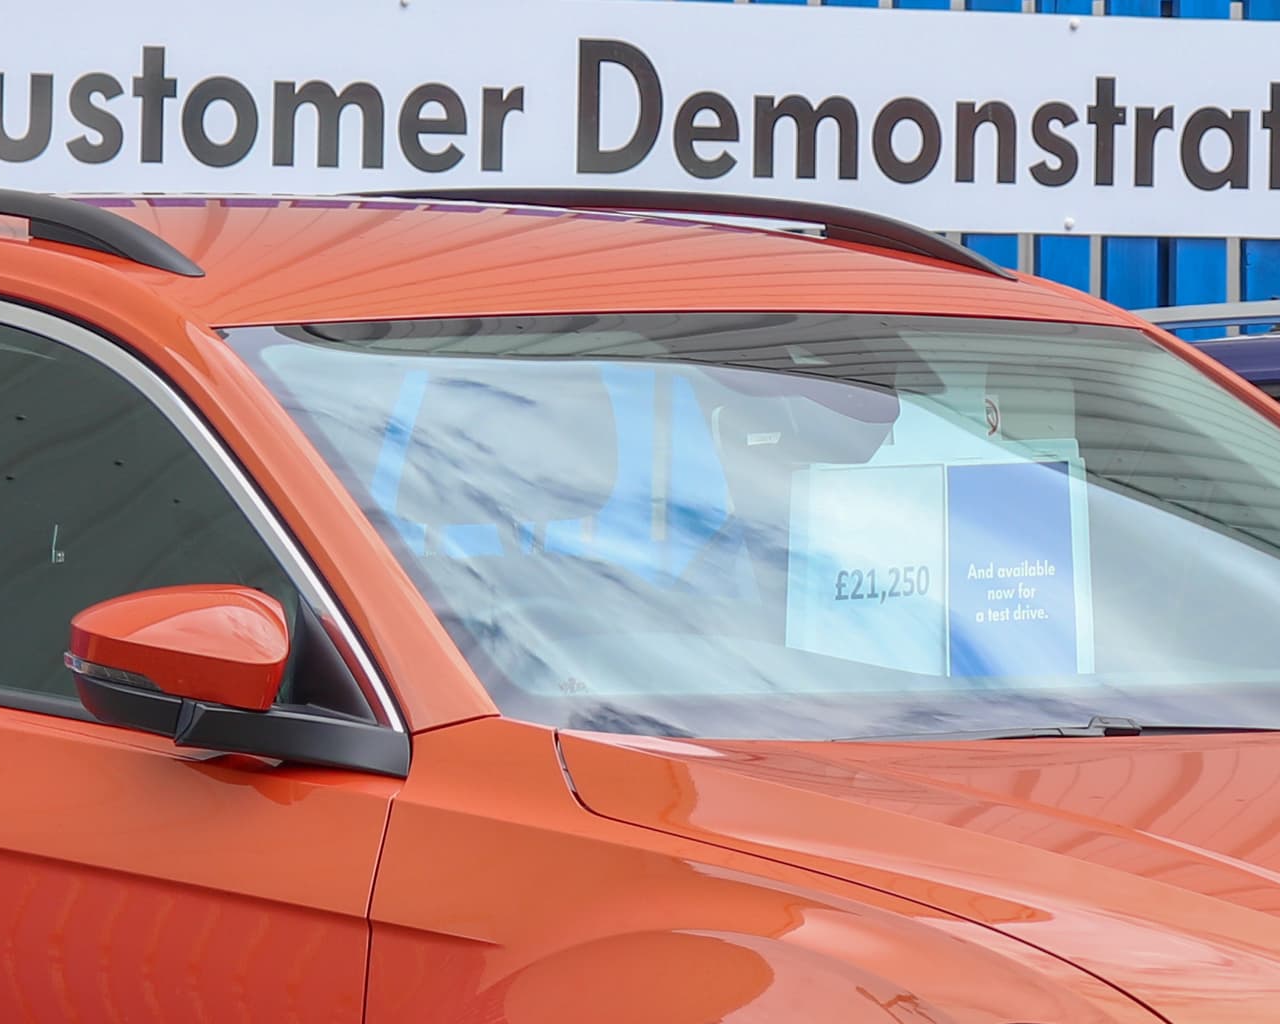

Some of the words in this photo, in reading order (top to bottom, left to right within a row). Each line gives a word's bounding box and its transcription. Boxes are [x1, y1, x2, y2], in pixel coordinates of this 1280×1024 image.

[967, 562, 994, 580] And
[997, 559, 1056, 578] available
[834, 565, 930, 604] £21,250
[987, 587, 1015, 601] now
[1018, 581, 1037, 599] for
[975, 610, 985, 623] a
[988, 607, 1010, 622] test
[1013, 602, 1049, 621] drive.
